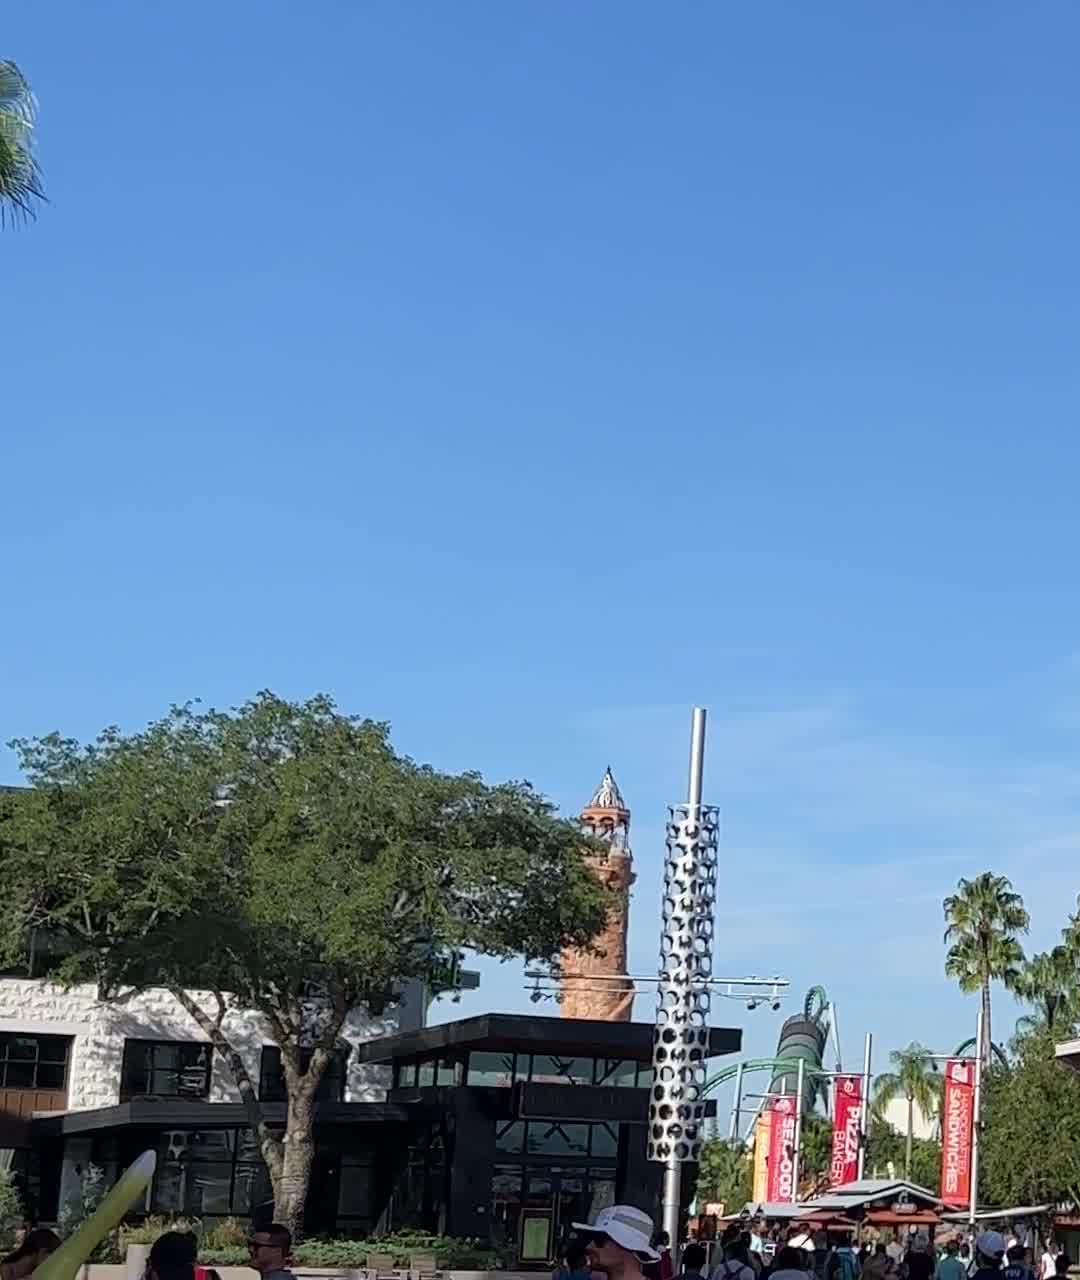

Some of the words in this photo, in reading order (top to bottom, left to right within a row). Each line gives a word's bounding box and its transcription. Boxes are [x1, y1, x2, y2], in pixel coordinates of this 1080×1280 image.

[779, 1118, 795, 1198] SEAOOD
[843, 1106, 861, 1164] PIZZA
[946, 1087, 961, 1194] SANDWICHES
